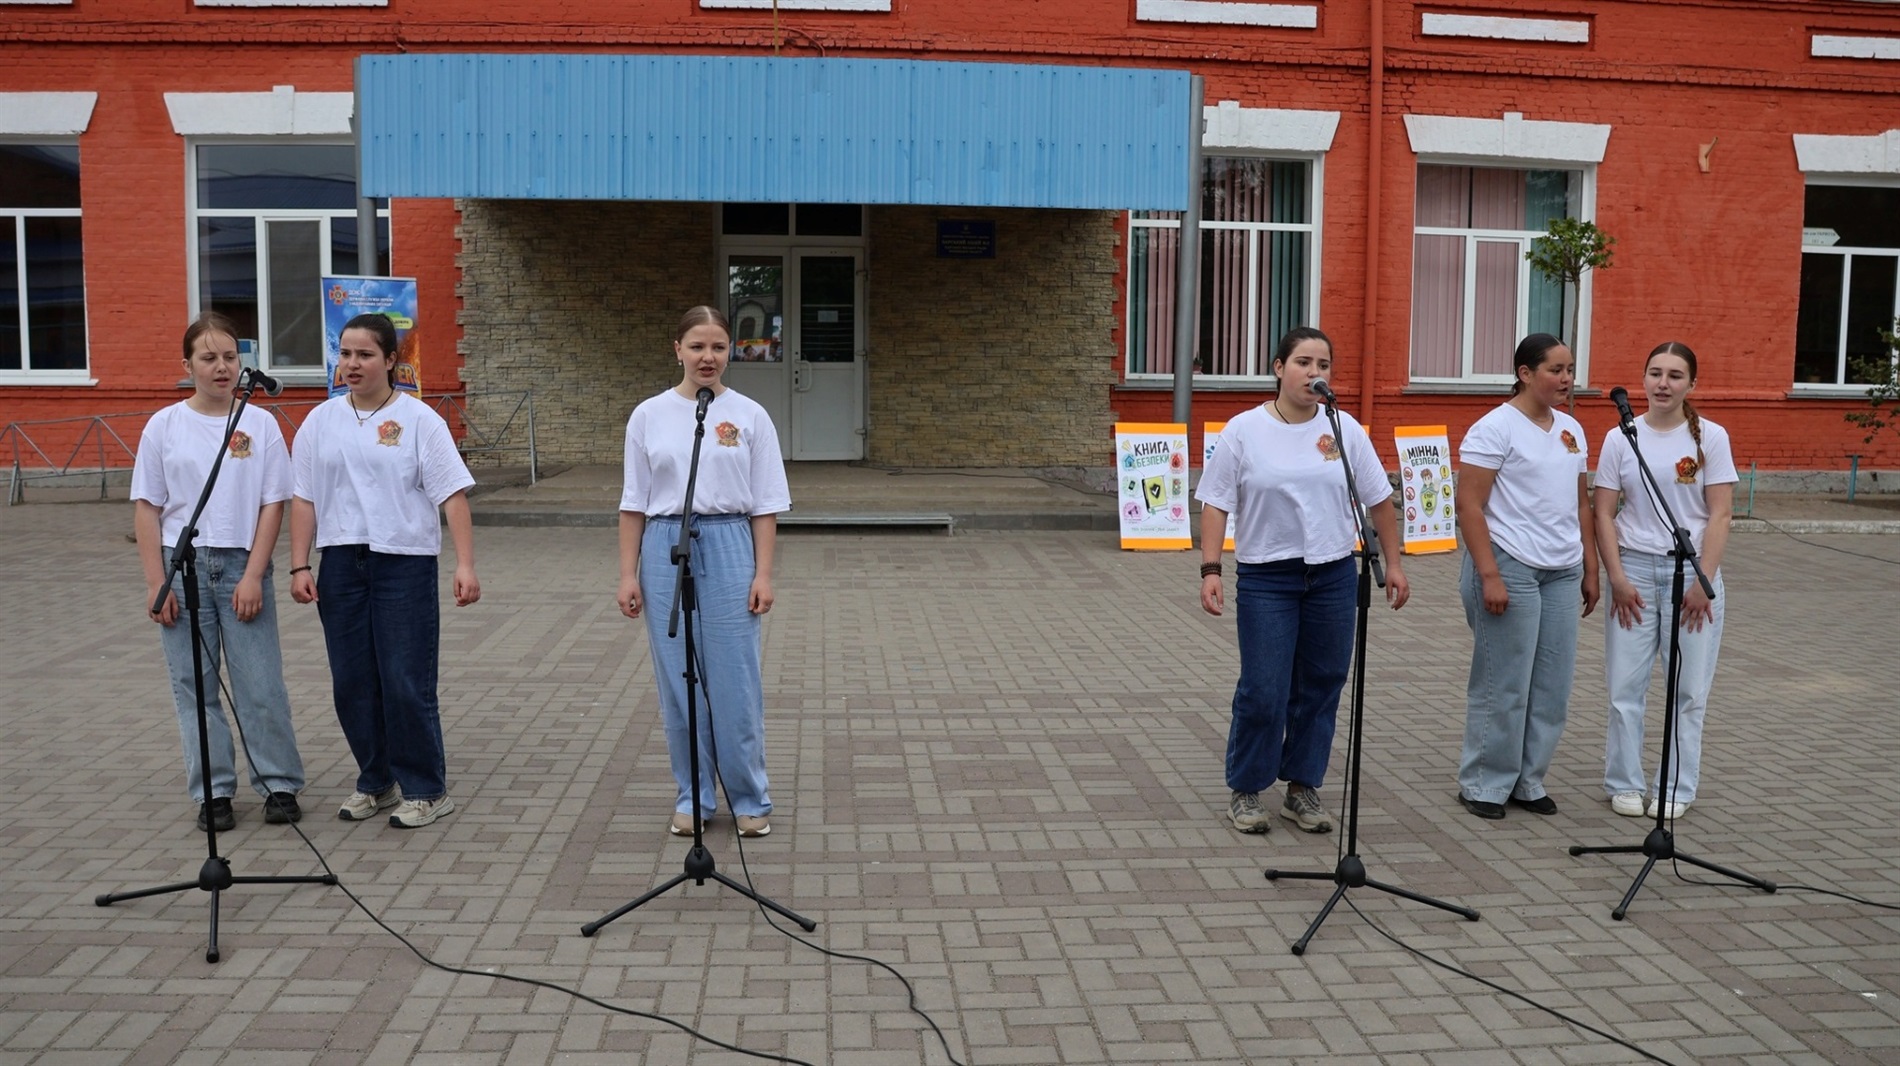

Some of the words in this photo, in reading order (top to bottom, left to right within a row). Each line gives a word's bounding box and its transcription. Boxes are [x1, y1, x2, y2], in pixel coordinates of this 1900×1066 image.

[1134, 441, 1169, 456] КНИГА
[1407, 445, 1439, 459] МІННА
[1136, 454, 1169, 468] БЕЗПЕКИ
[1411, 458, 1440, 467] БЕЗПЕКА
